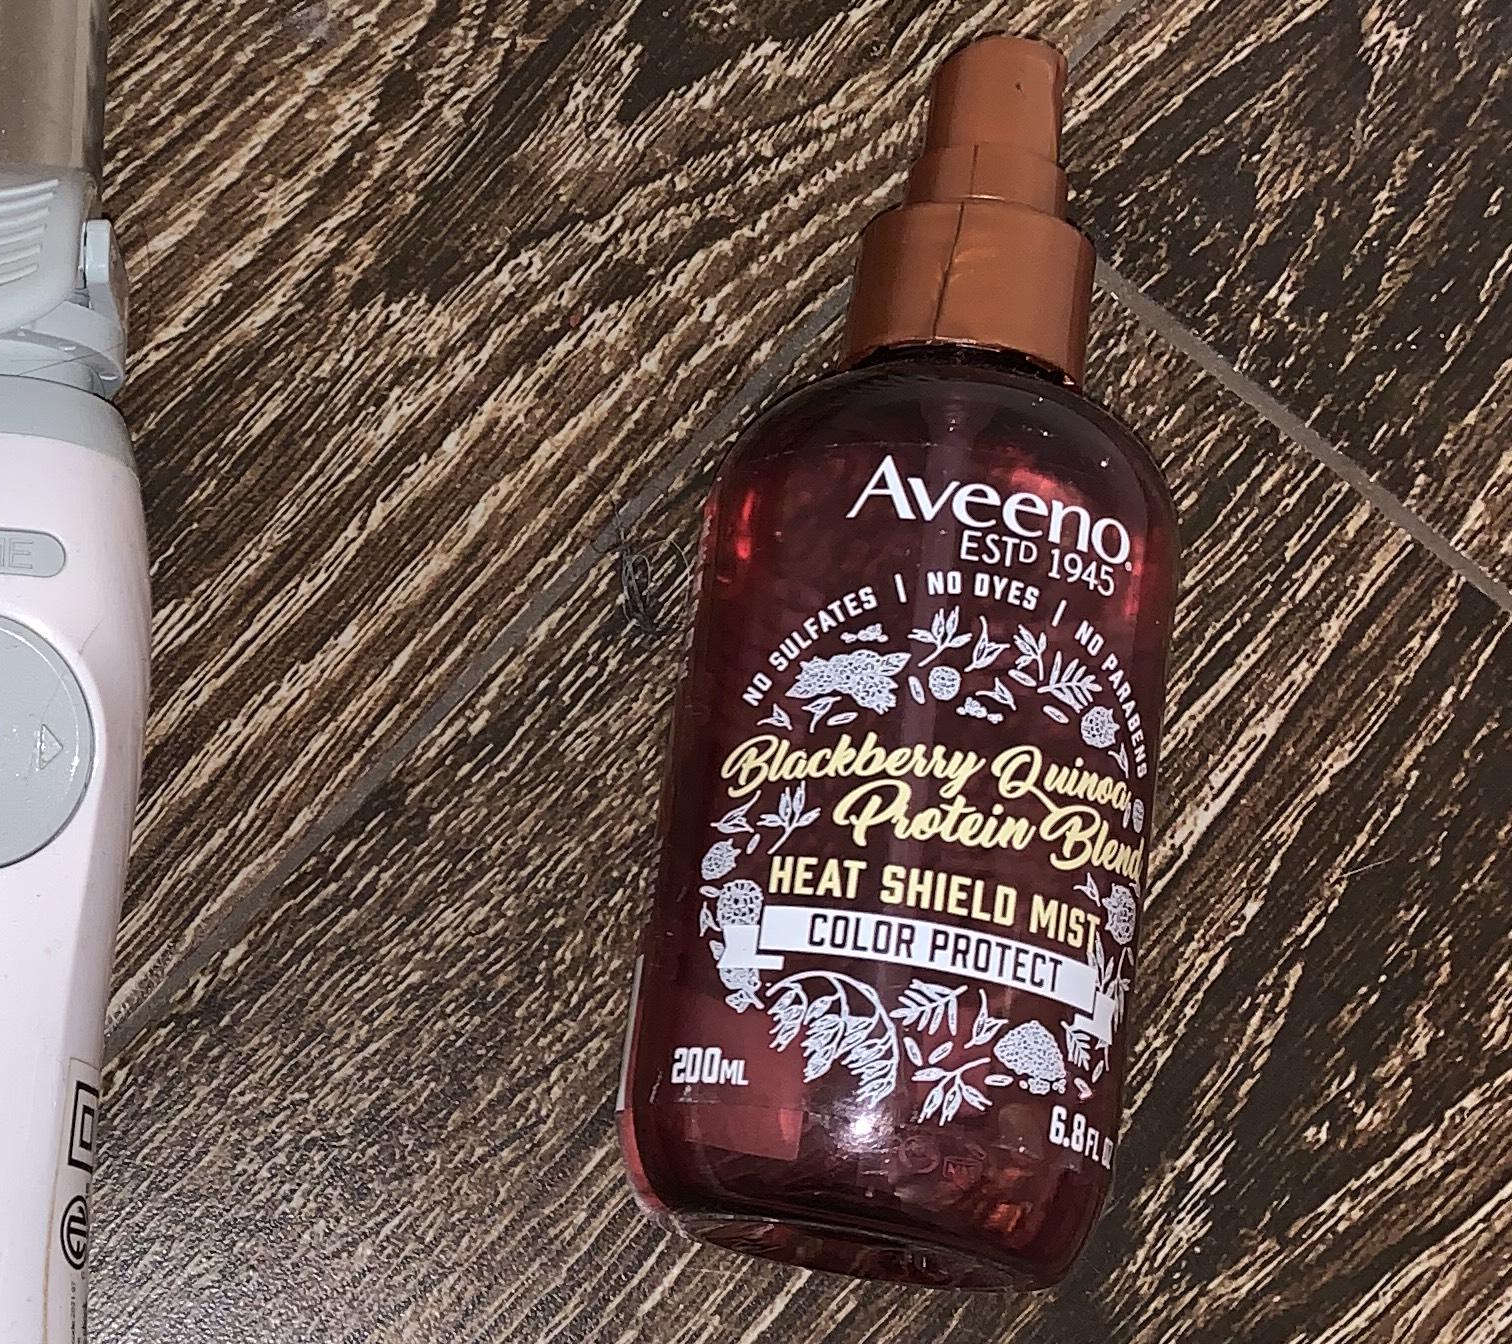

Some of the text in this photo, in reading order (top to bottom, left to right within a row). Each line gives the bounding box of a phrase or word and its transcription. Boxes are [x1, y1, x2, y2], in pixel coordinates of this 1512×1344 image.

[846, 455, 1131, 565] Aveeno
[960, 530, 1116, 597] ESTD 1945
[742, 571, 1148, 779] NO SULFATES NO DYES NO PARABENS
[721, 733, 1132, 812] Blackberry Quinoa
[833, 778, 1145, 882] Protein Blend
[768, 856, 1100, 952] HEAT SHIELD MIST
[807, 913, 1064, 993] COLOR PROTECT
[671, 1047, 749, 1086] 200ML
